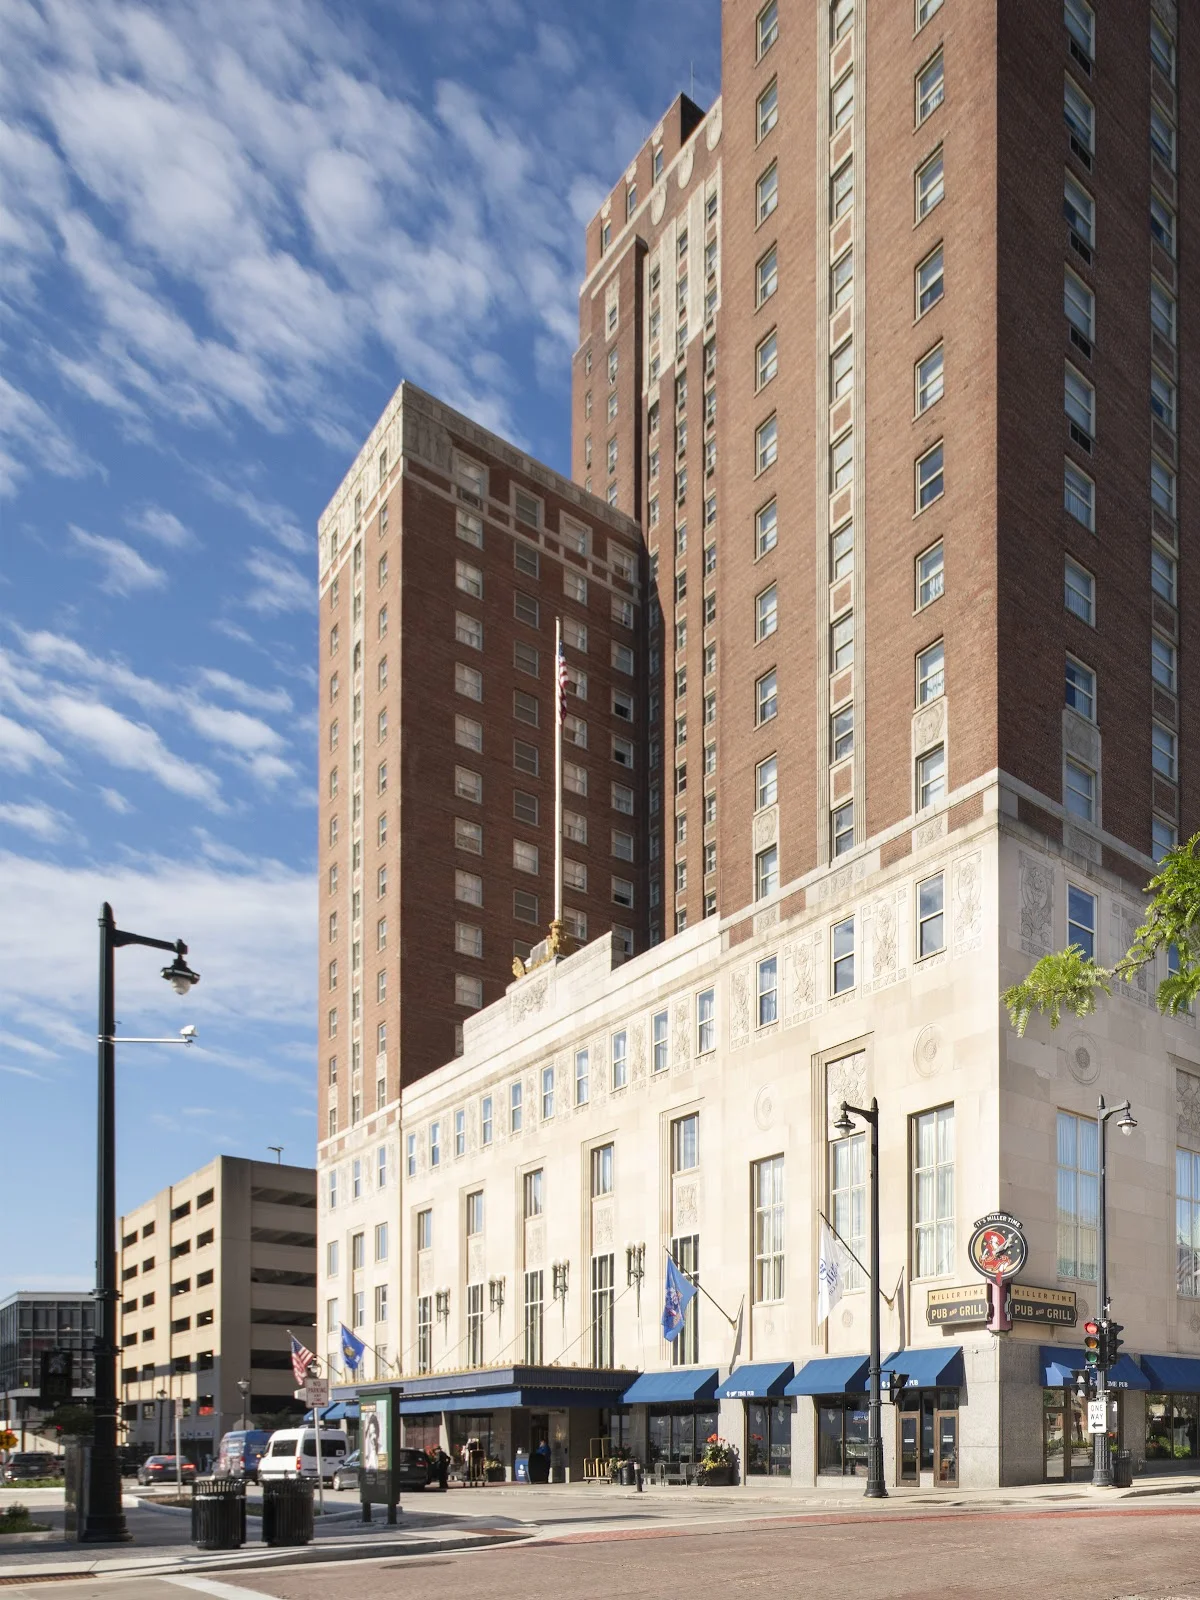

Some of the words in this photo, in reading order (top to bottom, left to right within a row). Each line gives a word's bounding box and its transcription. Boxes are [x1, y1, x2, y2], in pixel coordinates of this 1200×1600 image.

[976, 1218, 987, 1227] IT'S
[1008, 1217, 1021, 1228] TIME
[931, 1291, 960, 1300] MILLER
[1014, 1289, 1048, 1299] MILLER
[1052, 1294, 1072, 1302] TIME
[931, 1308, 947, 1319] PUB
[959, 1304, 983, 1316] GRILL
[1014, 1304, 1034, 1316] PUB
[1046, 1308, 1072, 1321] GRILL
